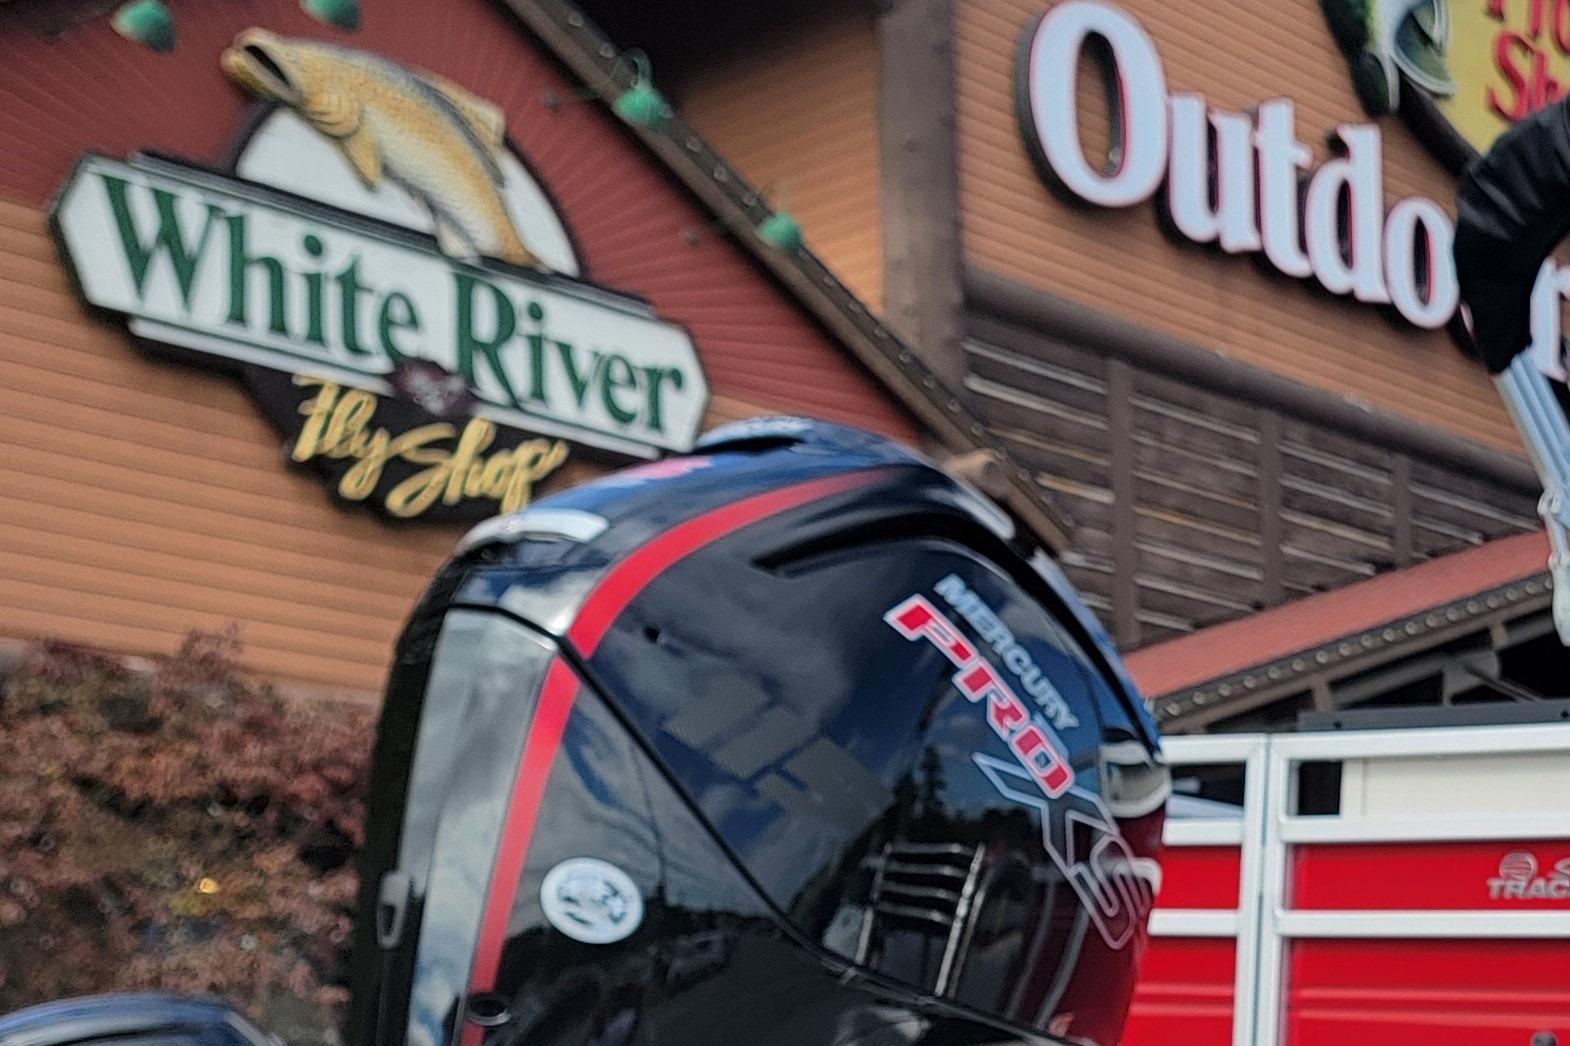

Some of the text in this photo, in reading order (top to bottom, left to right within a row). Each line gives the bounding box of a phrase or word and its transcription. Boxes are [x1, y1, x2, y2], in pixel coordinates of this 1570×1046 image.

[101, 172, 683, 434] White River
[292, 374, 570, 519] Fly Shop
[882, 593, 1076, 800] PRO
[932, 573, 1080, 730] MERCURY
